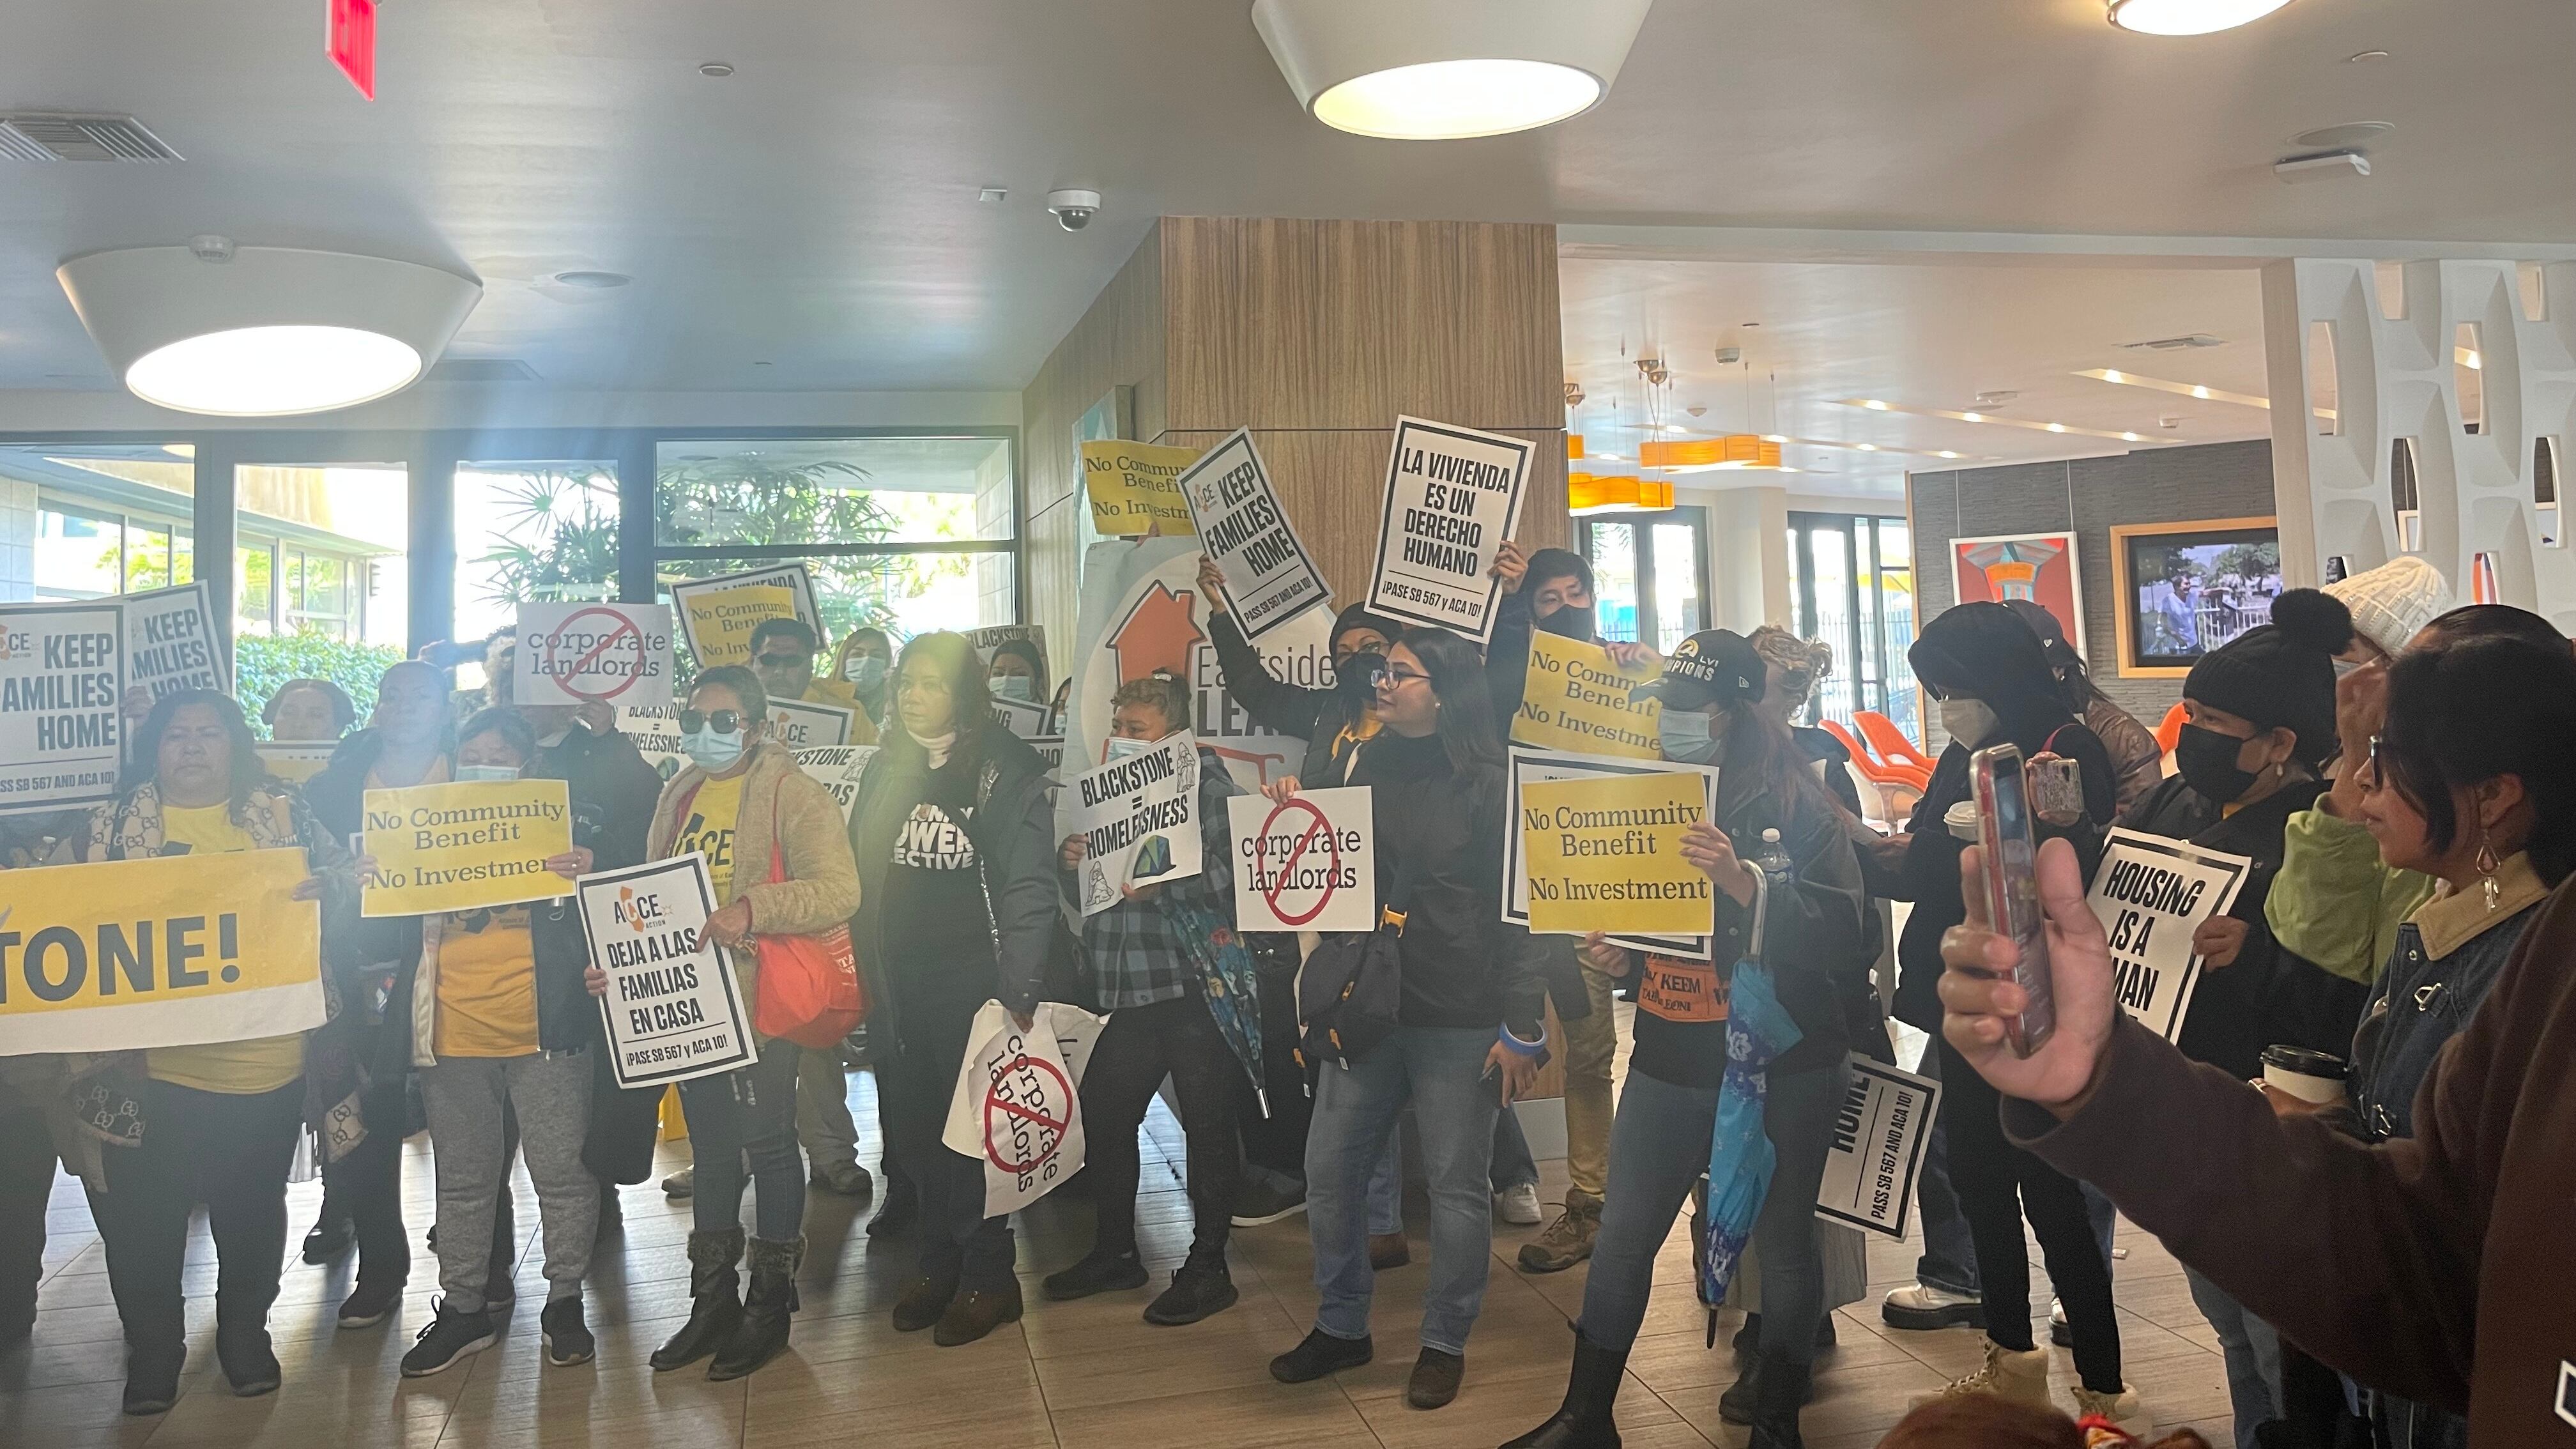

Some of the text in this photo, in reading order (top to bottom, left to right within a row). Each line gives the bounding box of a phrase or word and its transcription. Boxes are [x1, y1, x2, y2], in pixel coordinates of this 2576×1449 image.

[1085, 457, 1112, 472] No
[1402, 447, 1510, 493] LA VIVIENDA
[1218, 461, 1255, 509] KEEP
[1424, 483, 1476, 516] ES UN
[1094, 502, 1120, 516] No
[1205, 495, 1275, 560] FAMILIES
[1404, 509, 1482, 548] DERECHO
[1242, 528, 1296, 577] HOME
[1404, 537, 1478, 577] HUMANO
[691, 608, 712, 622] No
[1243, 606, 1263, 623] PASS
[1278, 588, 1292, 603] AND
[1383, 581, 1409, 599] ¡PASE
[1409, 588, 1422, 602] SB
[1422, 591, 1441, 607] 567
[1448, 598, 1468, 614] ACA
[1468, 602, 1482, 618] 10!
[144, 608, 199, 644] KEEP
[528, 632, 666, 654] corporate
[44, 632, 114, 669] KEEP
[532, 653, 659, 677] landlords
[702, 645, 723, 656] No
[1699, 656, 1719, 668] LVI
[1530, 650, 1641, 691] No Comm
[0, 672, 114, 712] AMILIES
[1565, 680, 1655, 716] Beneit
[1519, 702, 1550, 723] No
[37, 713, 116, 751] HOME
[16, 778, 29, 792] SB
[33, 776, 52, 790] 567
[54, 774, 76, 788] AND
[78, 772, 98, 786] ACA
[1080, 746, 1175, 808] BLACKSTONE
[367, 799, 565, 831] No Community
[1085, 795, 1188, 861] HOMELESSNESS
[1524, 801, 1703, 831] No Community
[415, 822, 521, 850] Benefit
[1241, 826, 1361, 864] corporate
[1561, 830, 1657, 857] Benefit
[892, 847, 974, 870] ECTIVE
[1247, 859, 1357, 891] landlords
[369, 869, 406, 890] No
[1529, 877, 1708, 901] No Investment
[2103, 859, 2206, 917] HOUSING
[645, 919, 666, 928] ACTION
[2108, 908, 2156, 957] IS A
[607, 928, 698, 969] DEJA A LAS
[619, 963, 699, 1002] FAMILIAS
[629, 997, 705, 1034] EN CASA
[626, 1050, 652, 1066] ¡PASE
[652, 1048, 664, 1062] SB
[664, 1045, 682, 1059] 567
[693, 1038, 712, 1054] ACA
[712, 1034, 728, 1050] 10!
[988, 1050, 1033, 1193] landlords
[1008, 1035, 1061, 1181] corporate
[1871, 1091, 1913, 1220] PASS SB 567 AND ACA 10!
